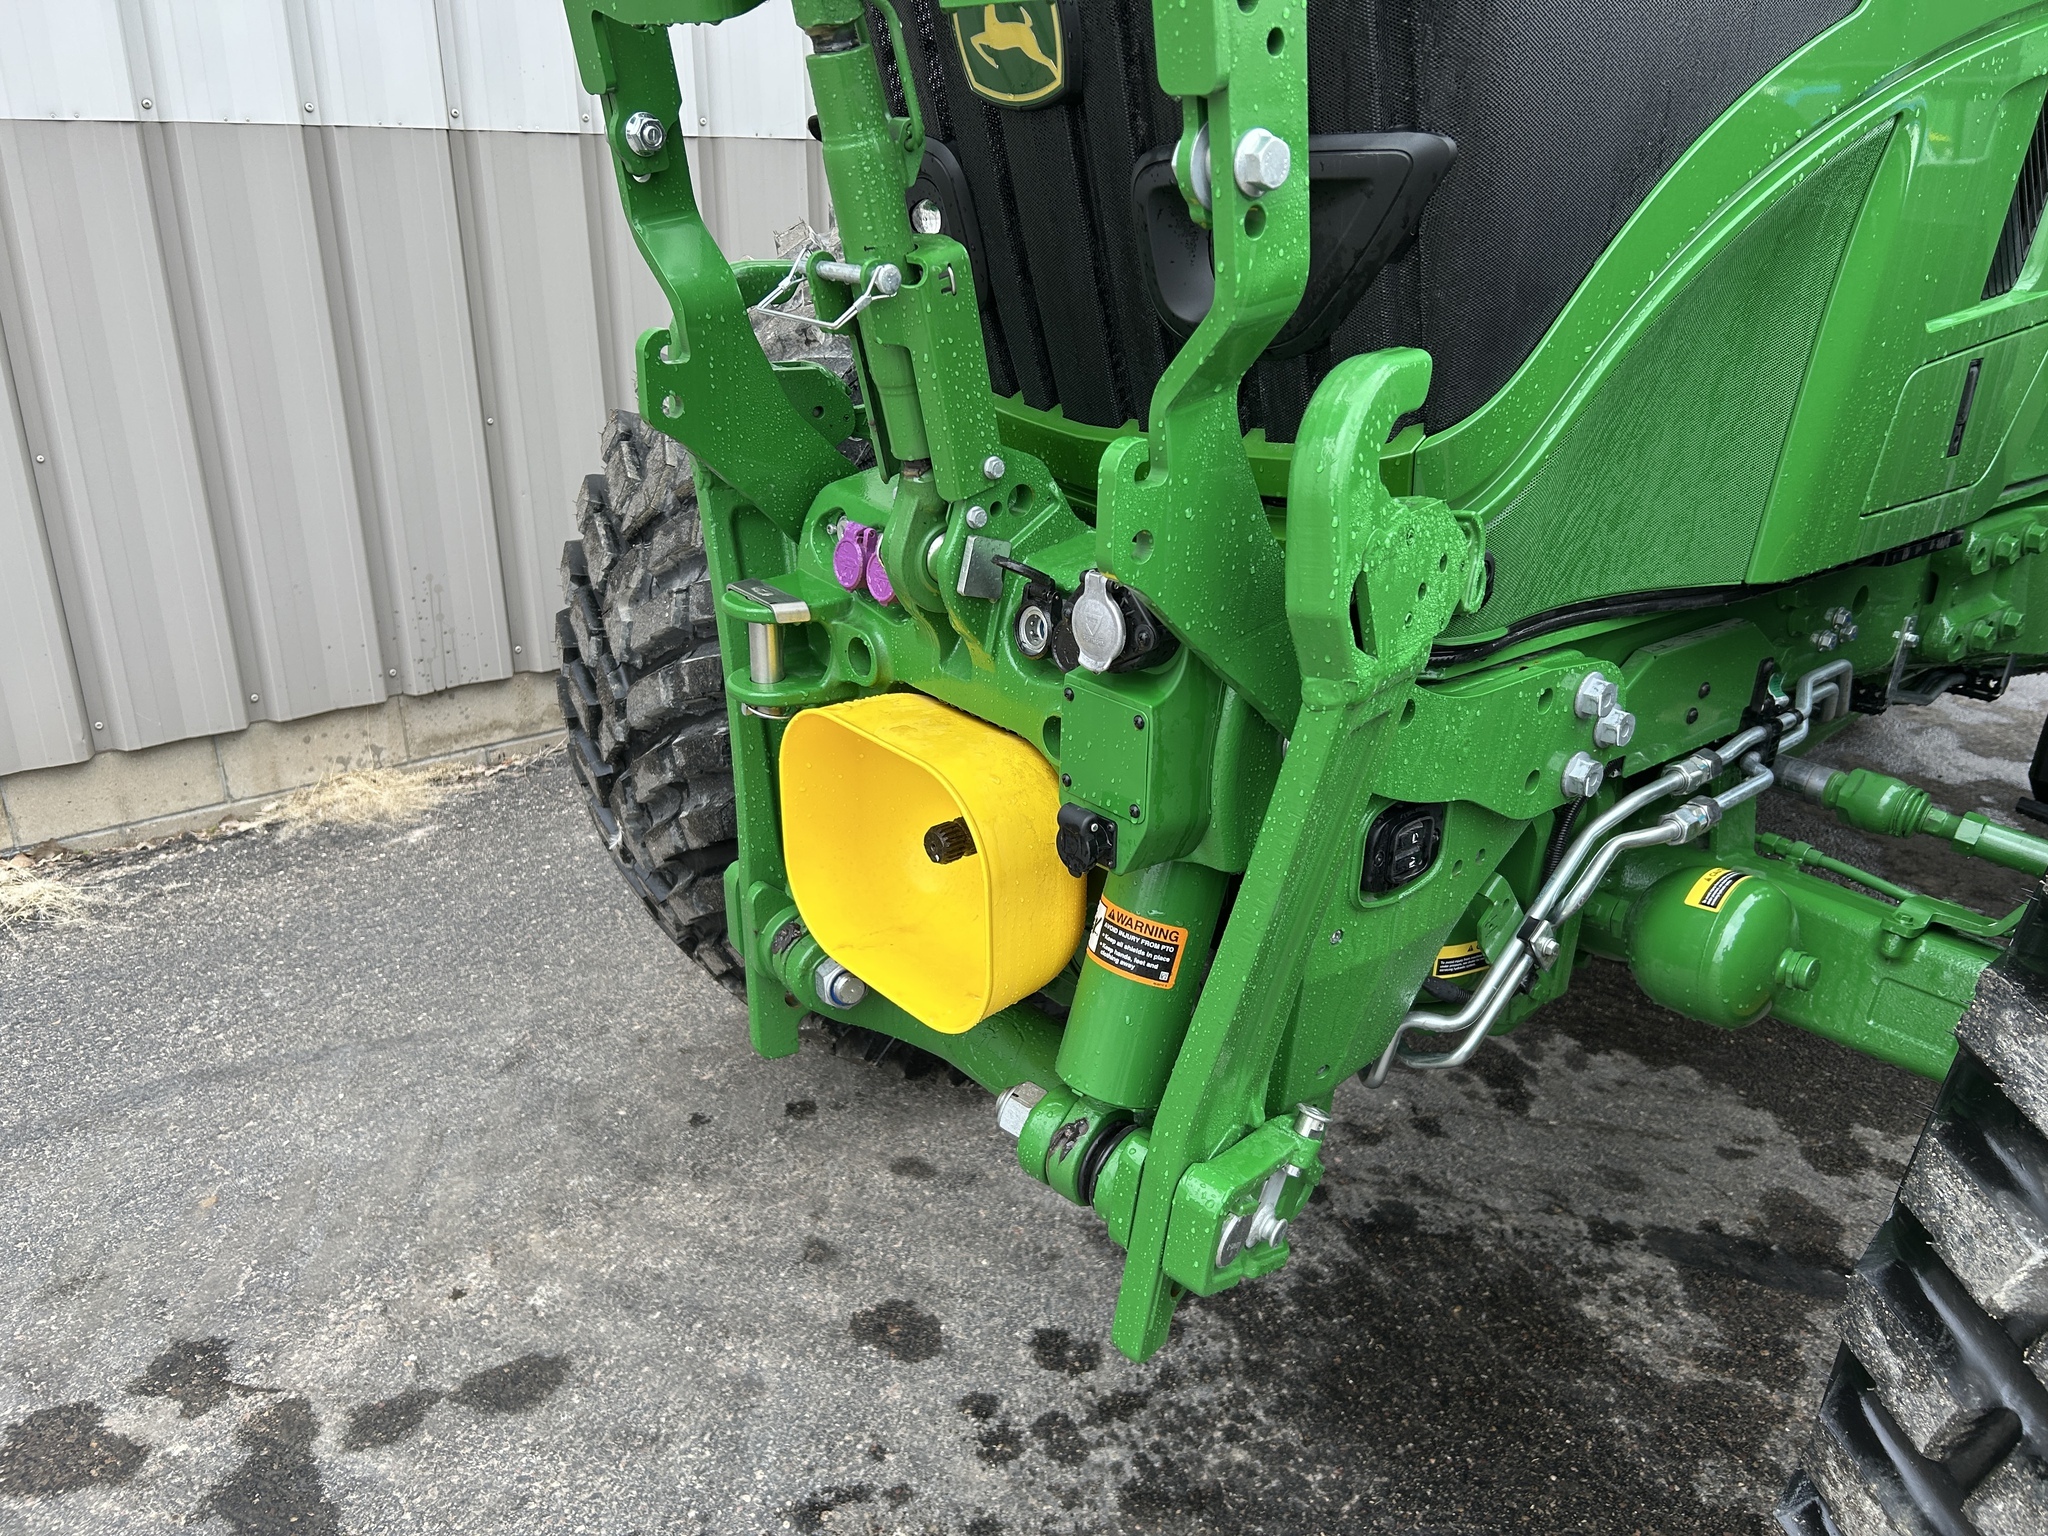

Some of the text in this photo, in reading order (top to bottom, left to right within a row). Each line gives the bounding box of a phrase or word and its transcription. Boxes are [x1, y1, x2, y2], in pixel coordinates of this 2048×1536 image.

[1104, 922, 1175, 953] AVOID INJURY FROM PTO
[1117, 911, 1180, 943] WARNING
[1104, 934, 1117, 945] Keep
[1124, 943, 1146, 956] shields
[1153, 953, 1171, 963] place
[1114, 947, 1133, 962] hands,
[1134, 957, 1146, 966] feet
[1146, 961, 1159, 970] and
